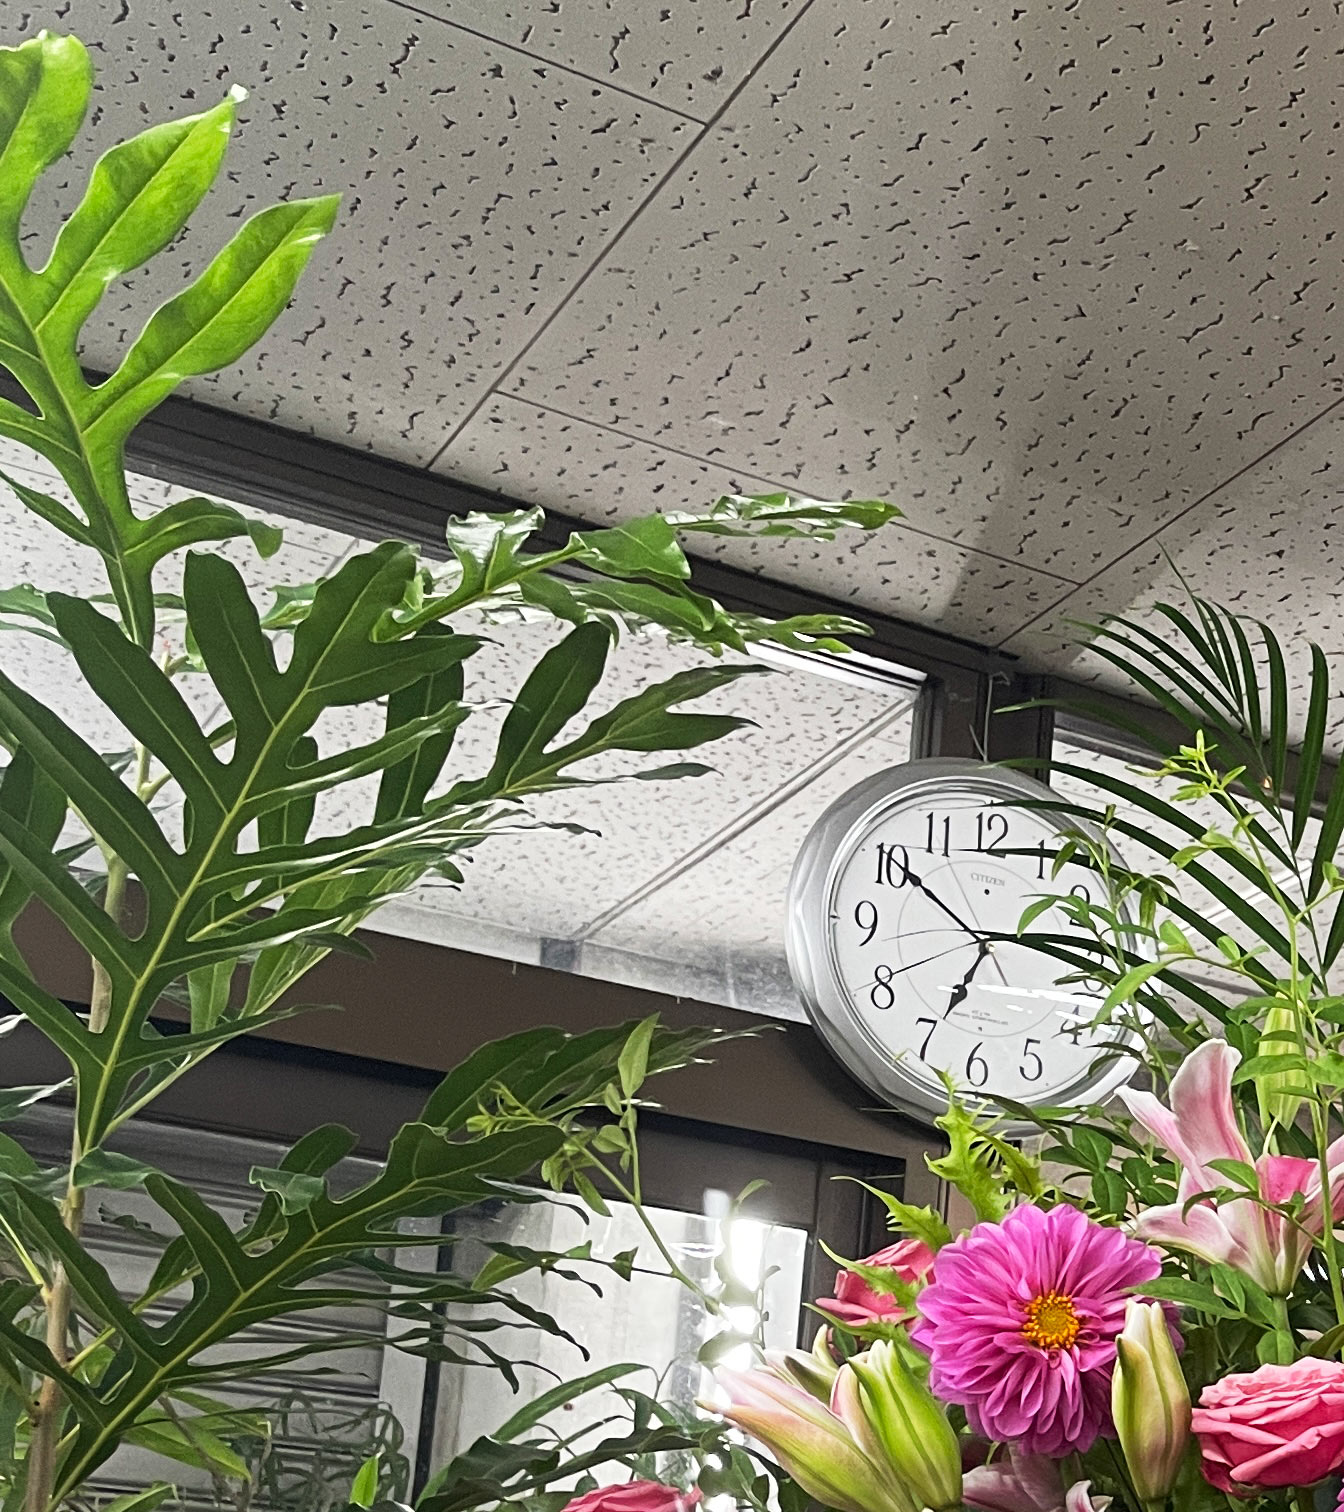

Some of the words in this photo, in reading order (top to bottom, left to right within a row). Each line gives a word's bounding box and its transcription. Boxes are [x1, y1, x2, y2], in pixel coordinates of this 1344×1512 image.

[926, 812, 951, 857] 11
[975, 812, 1009, 859] 12
[875, 842, 909, 888] 10
[970, 872, 1006, 887] CITIZEN
[1036, 839, 1046, 880] 1
[854, 901, 878, 947] 9
[870, 965, 895, 1009] 8
[915, 1017, 938, 1061] 7
[1019, 1037, 1043, 1081] 5
[966, 1041, 989, 1087] 6
